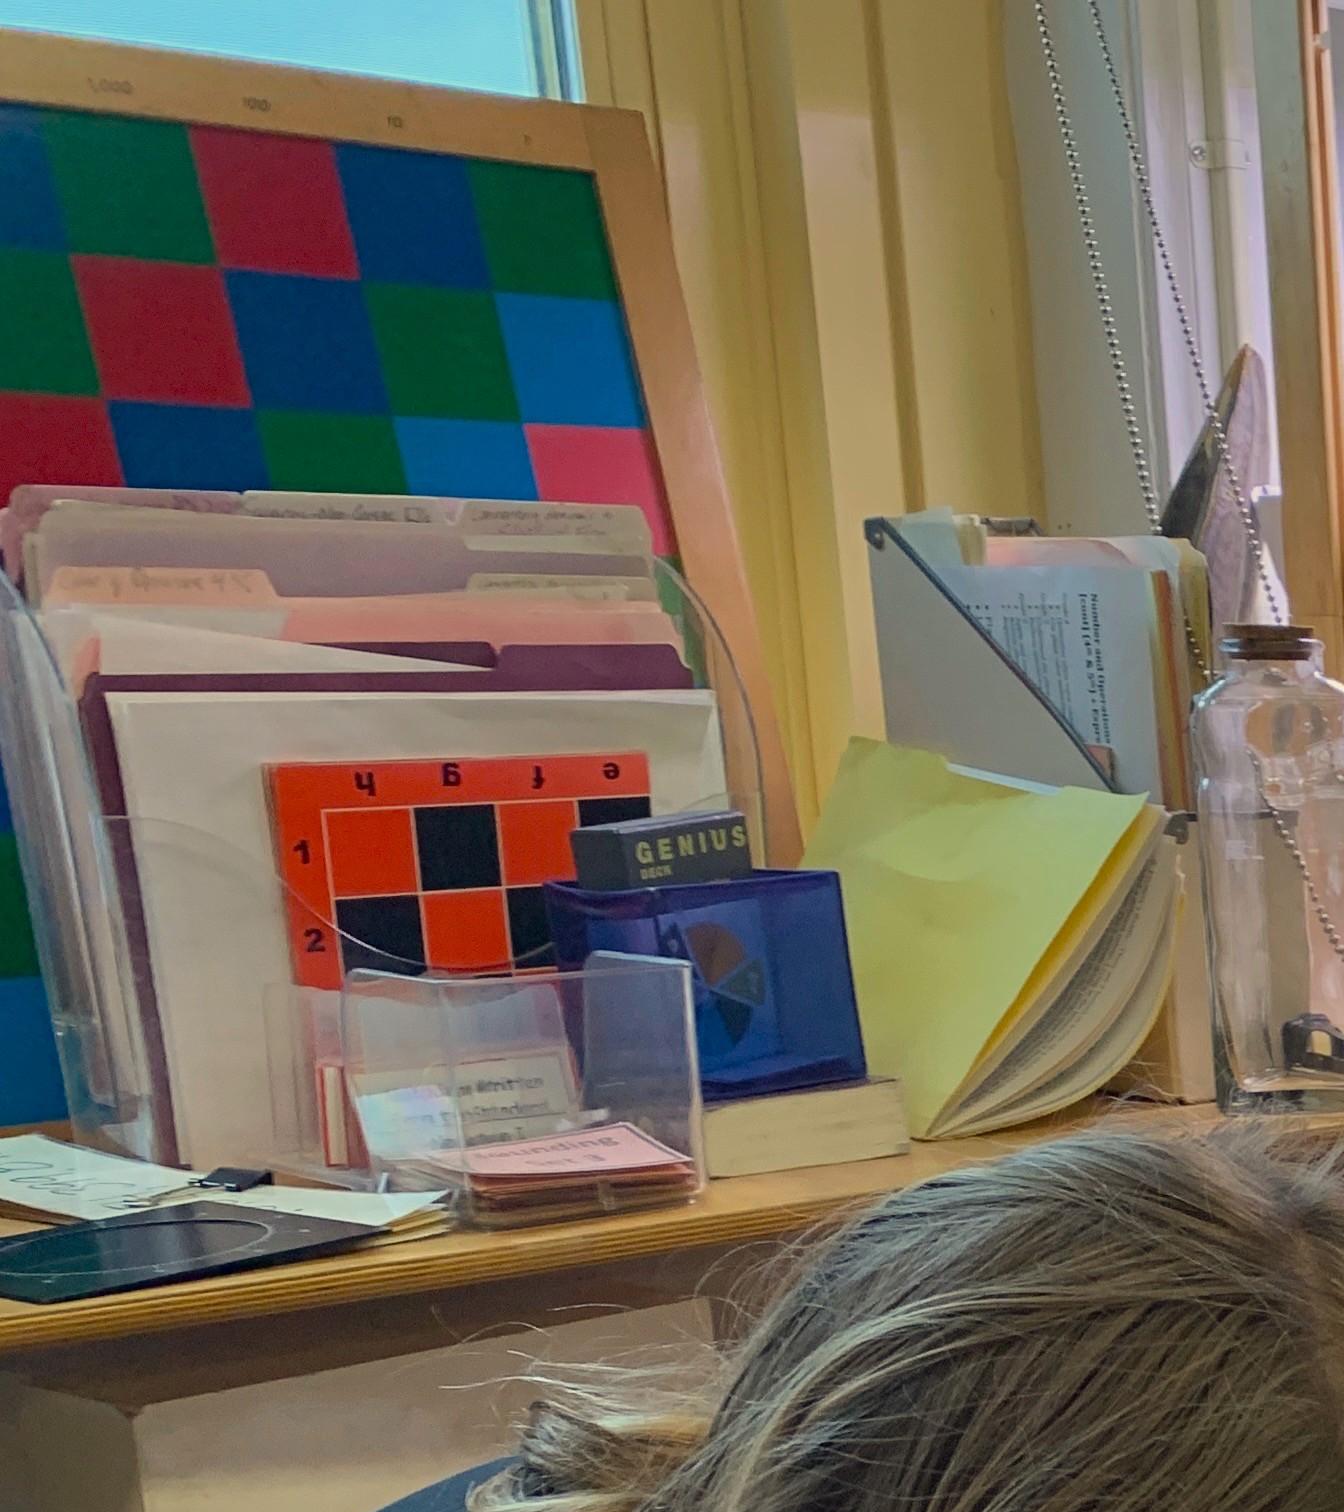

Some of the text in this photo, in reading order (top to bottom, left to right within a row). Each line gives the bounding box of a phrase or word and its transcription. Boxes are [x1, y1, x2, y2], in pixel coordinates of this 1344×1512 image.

[602, 761, 621, 781] e
[293, 838, 311, 866] 1
[634, 824, 748, 866] GENIUS
[639, 864, 673, 881] DECK
[304, 927, 327, 954] 2
